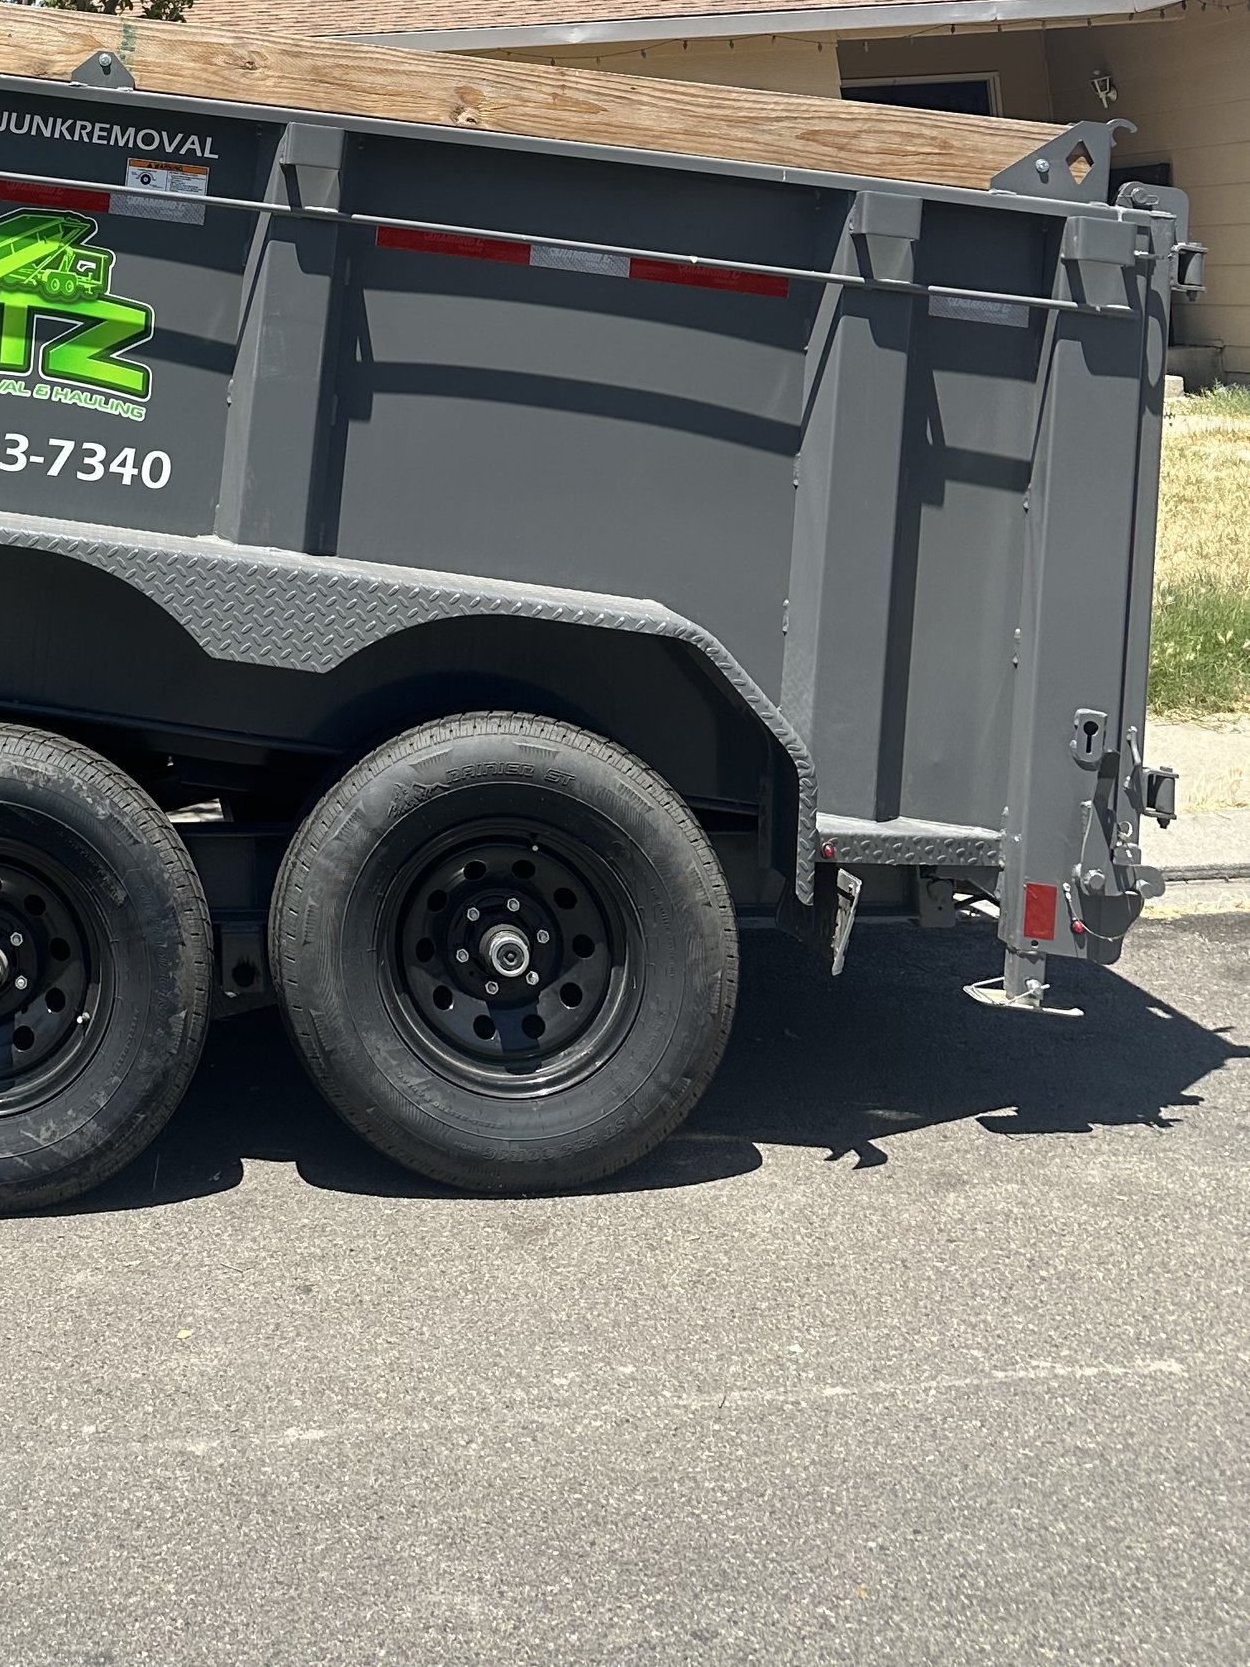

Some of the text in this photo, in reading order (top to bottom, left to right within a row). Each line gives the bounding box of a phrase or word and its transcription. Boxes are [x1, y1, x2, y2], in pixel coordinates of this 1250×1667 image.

[33, 384, 51, 400] &
[51, 387, 147, 422] HAULING
[446, 761, 576, 786] RAINIER ST
